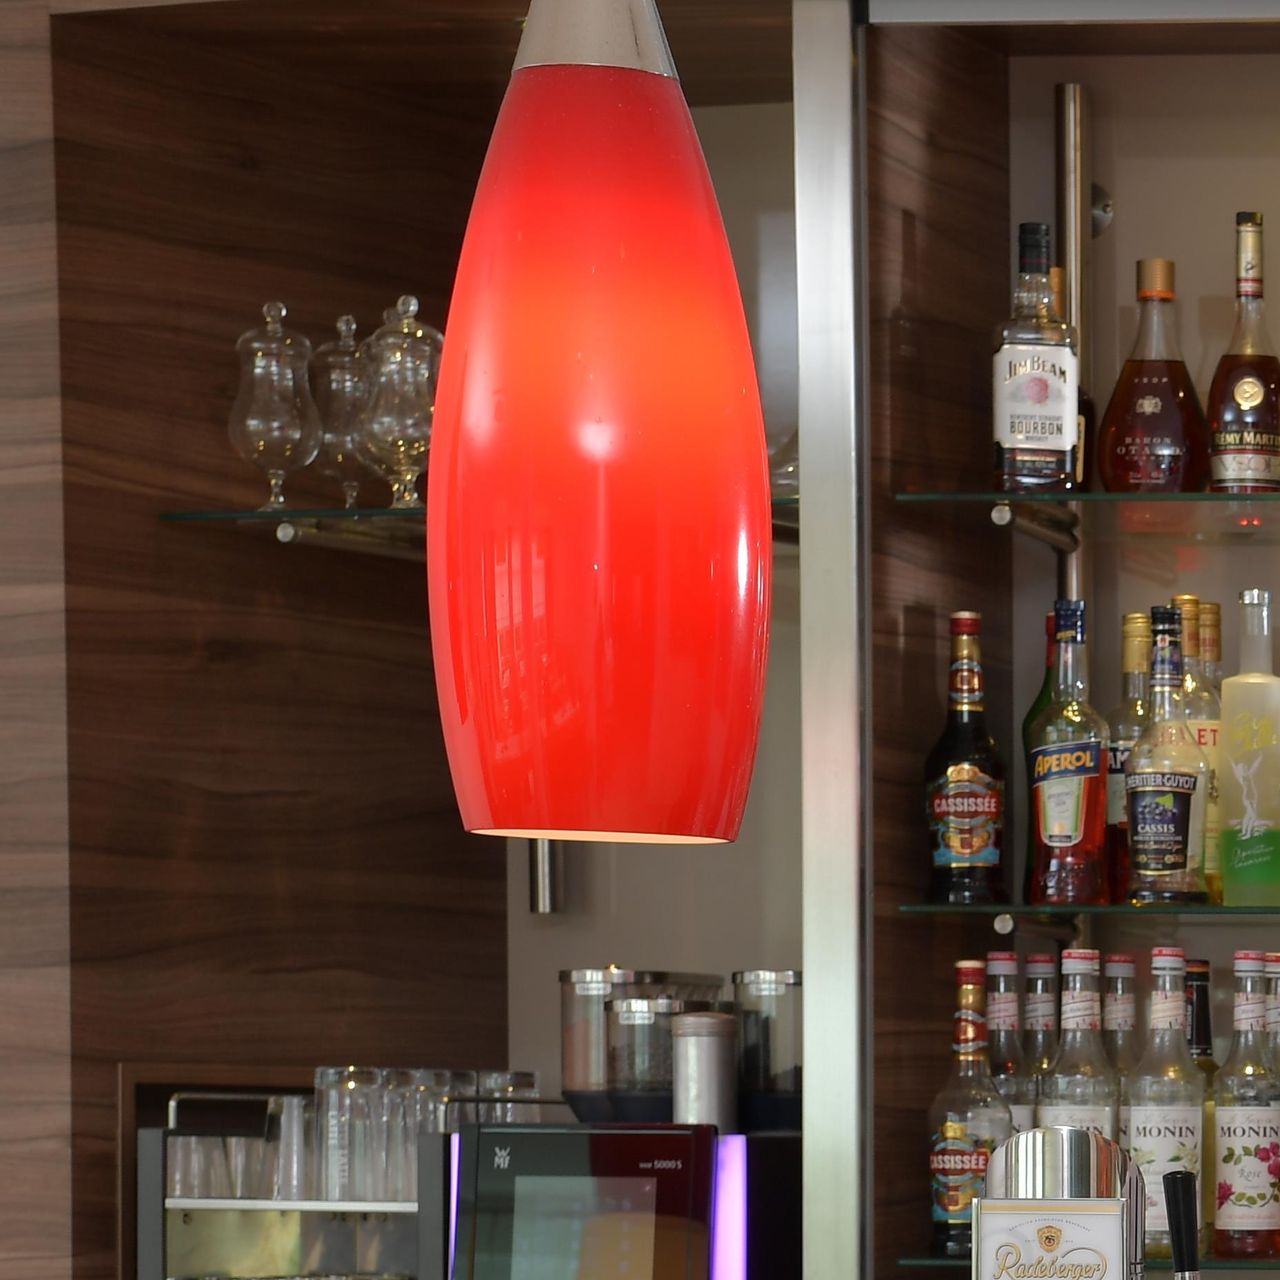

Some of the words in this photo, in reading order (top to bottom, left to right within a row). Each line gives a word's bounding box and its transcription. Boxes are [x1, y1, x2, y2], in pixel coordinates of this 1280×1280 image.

[1032, 356, 1066, 383] BEAM
[1009, 420, 1063, 436] BOURBON
[1215, 432, 1242, 446] RÉMY
[1034, 751, 1094, 778] APEROL
[934, 796, 997, 813] CASSISSÉE
[1137, 823, 1175, 834] CASSIS
[1136, 1125, 1196, 1138] MONIN
[1220, 1125, 1280, 1138] MONIN
[494, 1146, 511, 1169] WMF
[930, 1151, 986, 1169] ASSISSÉE
